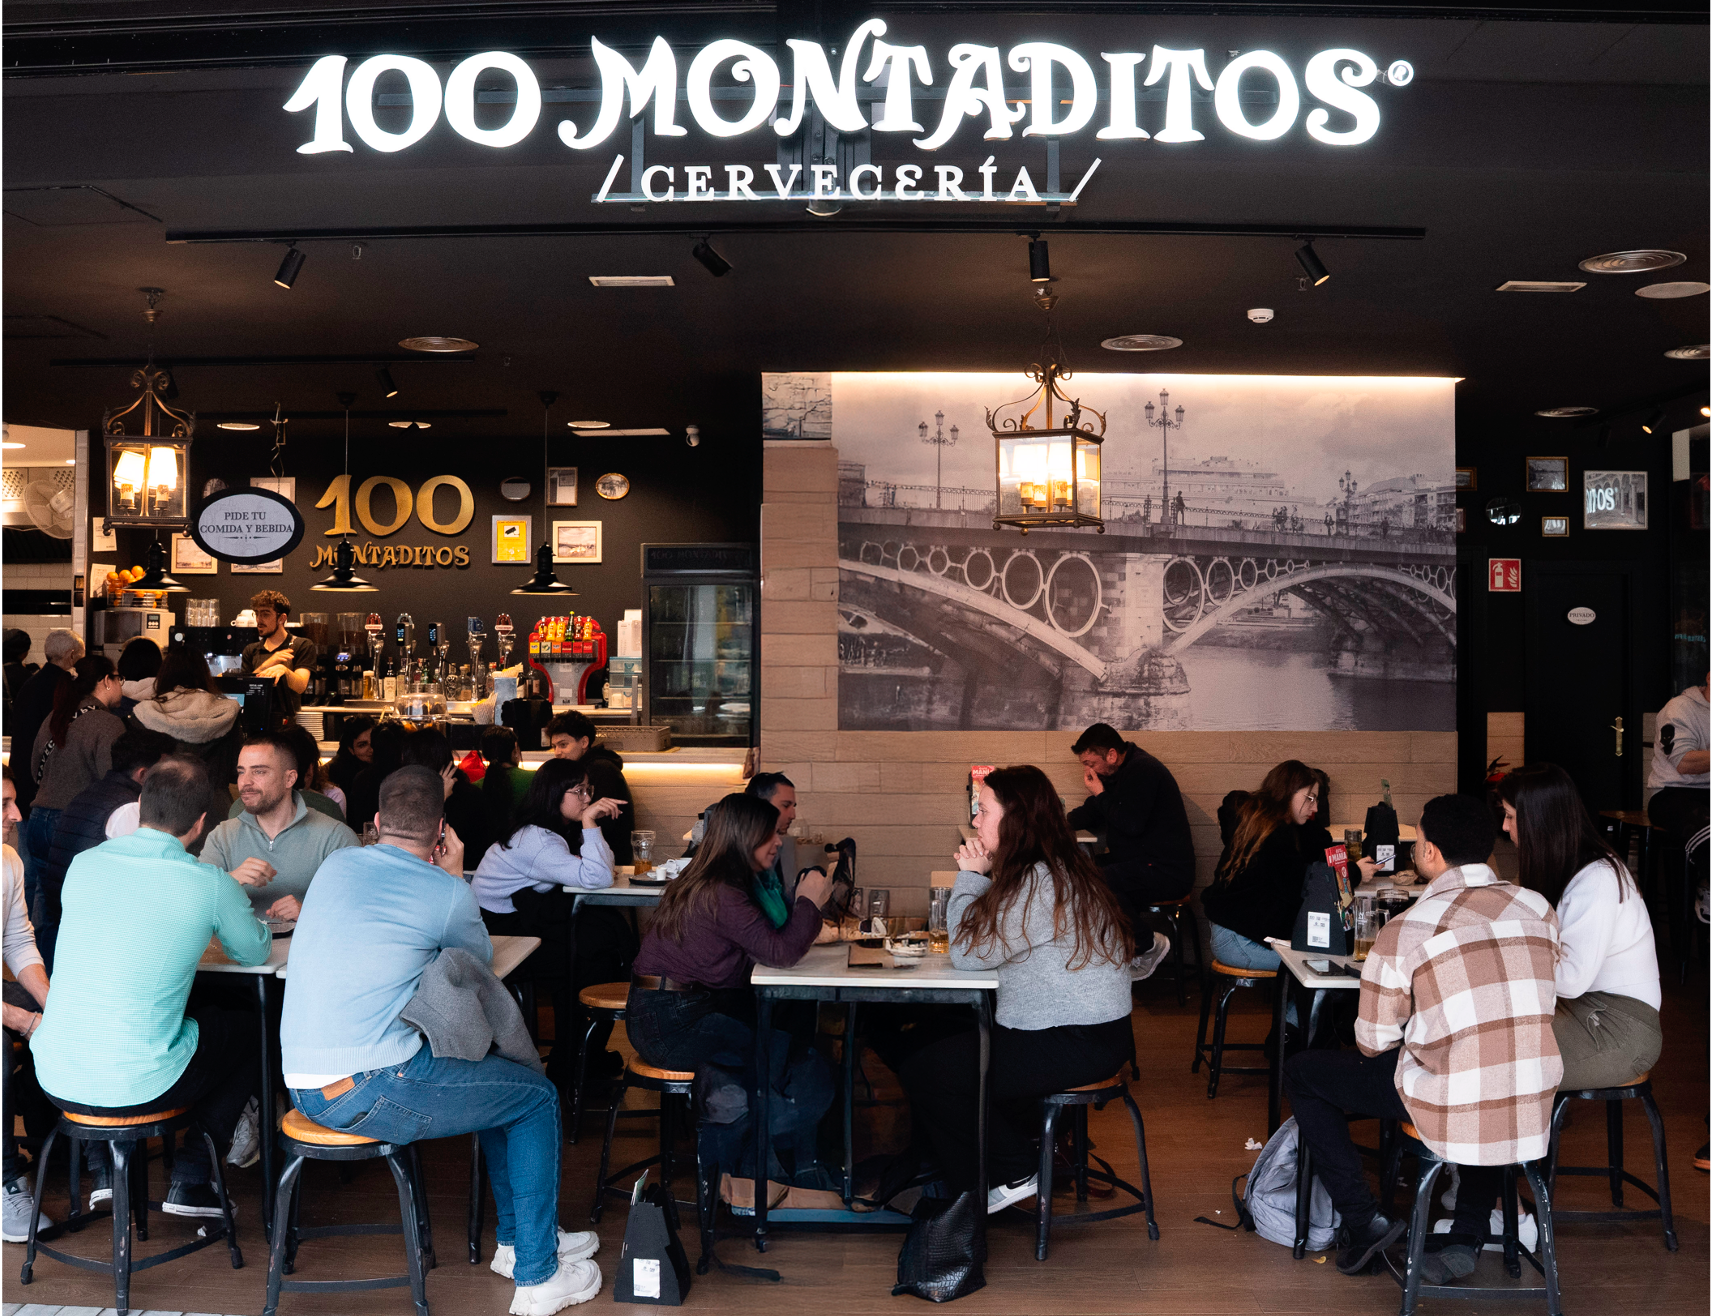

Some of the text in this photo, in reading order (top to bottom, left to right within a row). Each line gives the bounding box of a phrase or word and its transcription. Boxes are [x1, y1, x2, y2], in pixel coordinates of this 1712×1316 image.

[282, 50, 542, 155] 100
[224, 511, 266, 520] PIDE TU
[314, 474, 475, 537] 100
[199, 524, 294, 534] COMIDA Y BEBIDA
[309, 541, 470, 569] MNTADITOS
